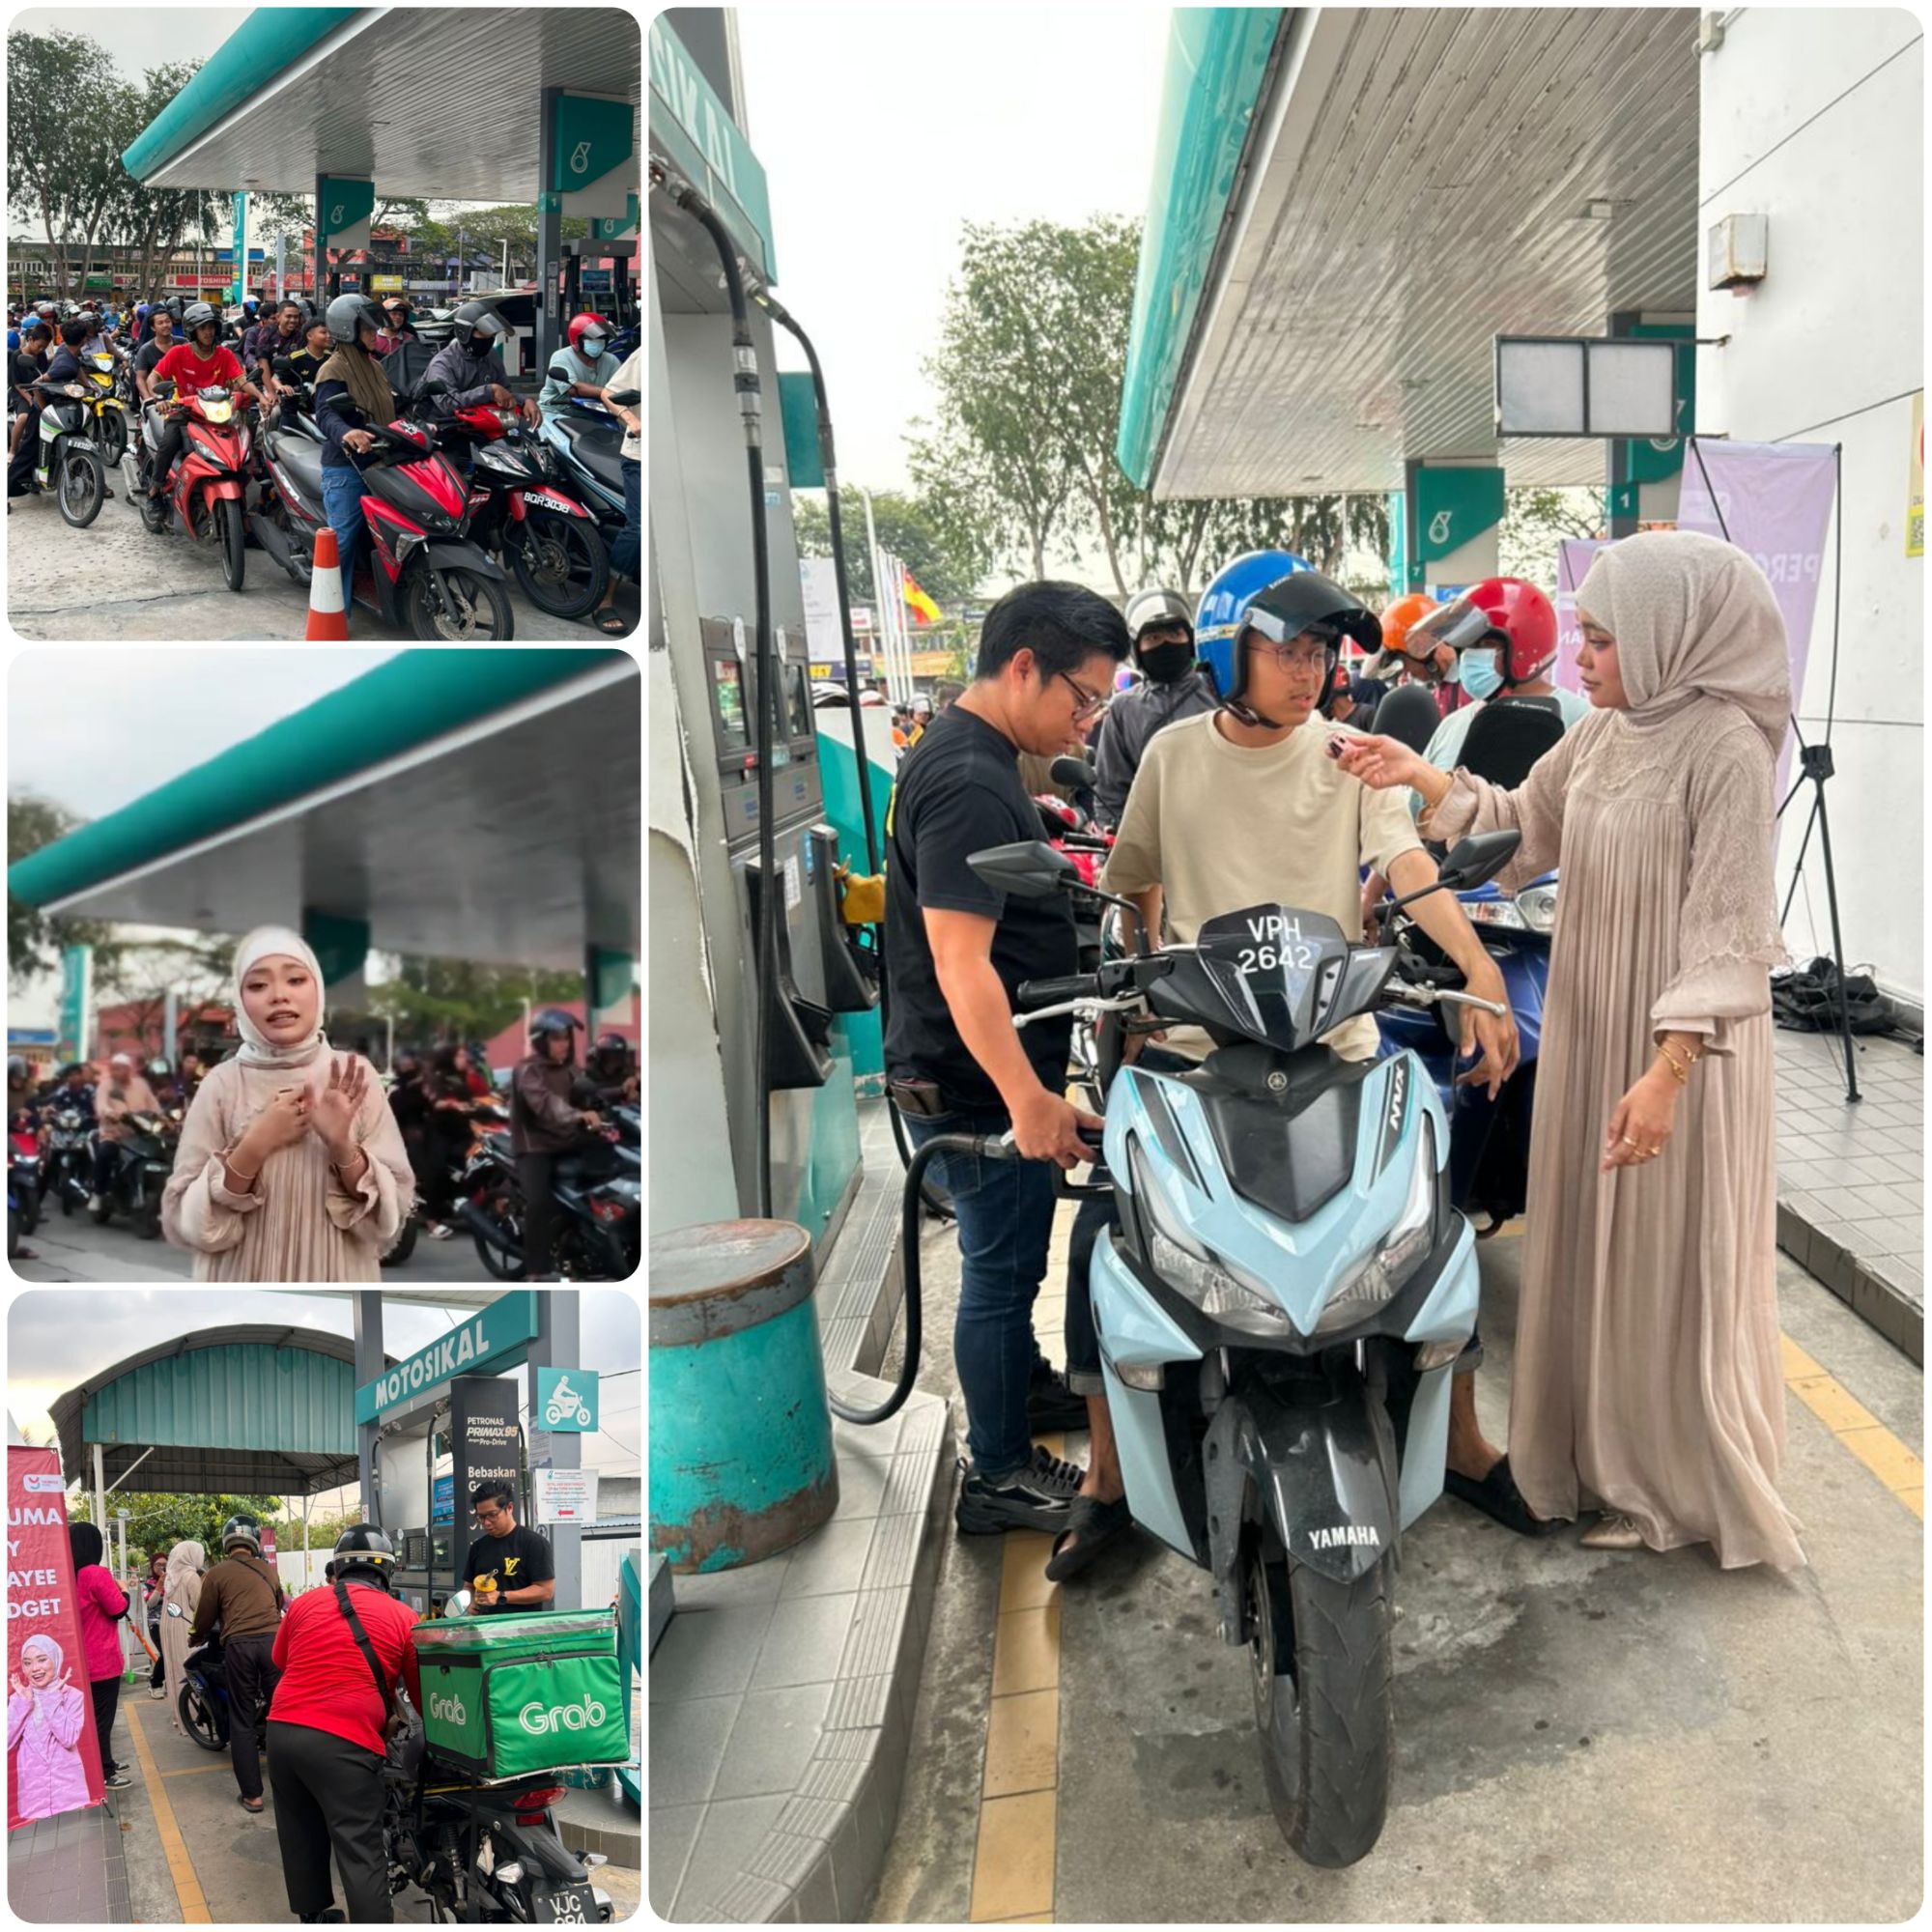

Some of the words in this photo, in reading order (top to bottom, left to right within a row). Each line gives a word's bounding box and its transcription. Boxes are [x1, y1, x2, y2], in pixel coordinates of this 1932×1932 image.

[1620, 492, 1629, 508] 1
[1247, 916, 1301, 943] VPH
[1238, 946, 1314, 975] 2642
[1389, 1065, 1405, 1130] NVX
[375, 1319, 490, 1410] MOTOSIKAL
[467, 1416, 504, 1426] PETRONAS
[479, 1437, 507, 1446] Pro-Drive
[468, 1466, 516, 1478] Bebaskan
[1308, 1525, 1380, 1549] YAMAHA
[8, 1569, 57, 1588] AYEE
[429, 1692, 466, 1725] Grab
[519, 1692, 606, 1735] Grab
[549, 1894, 581, 1916] VJC
